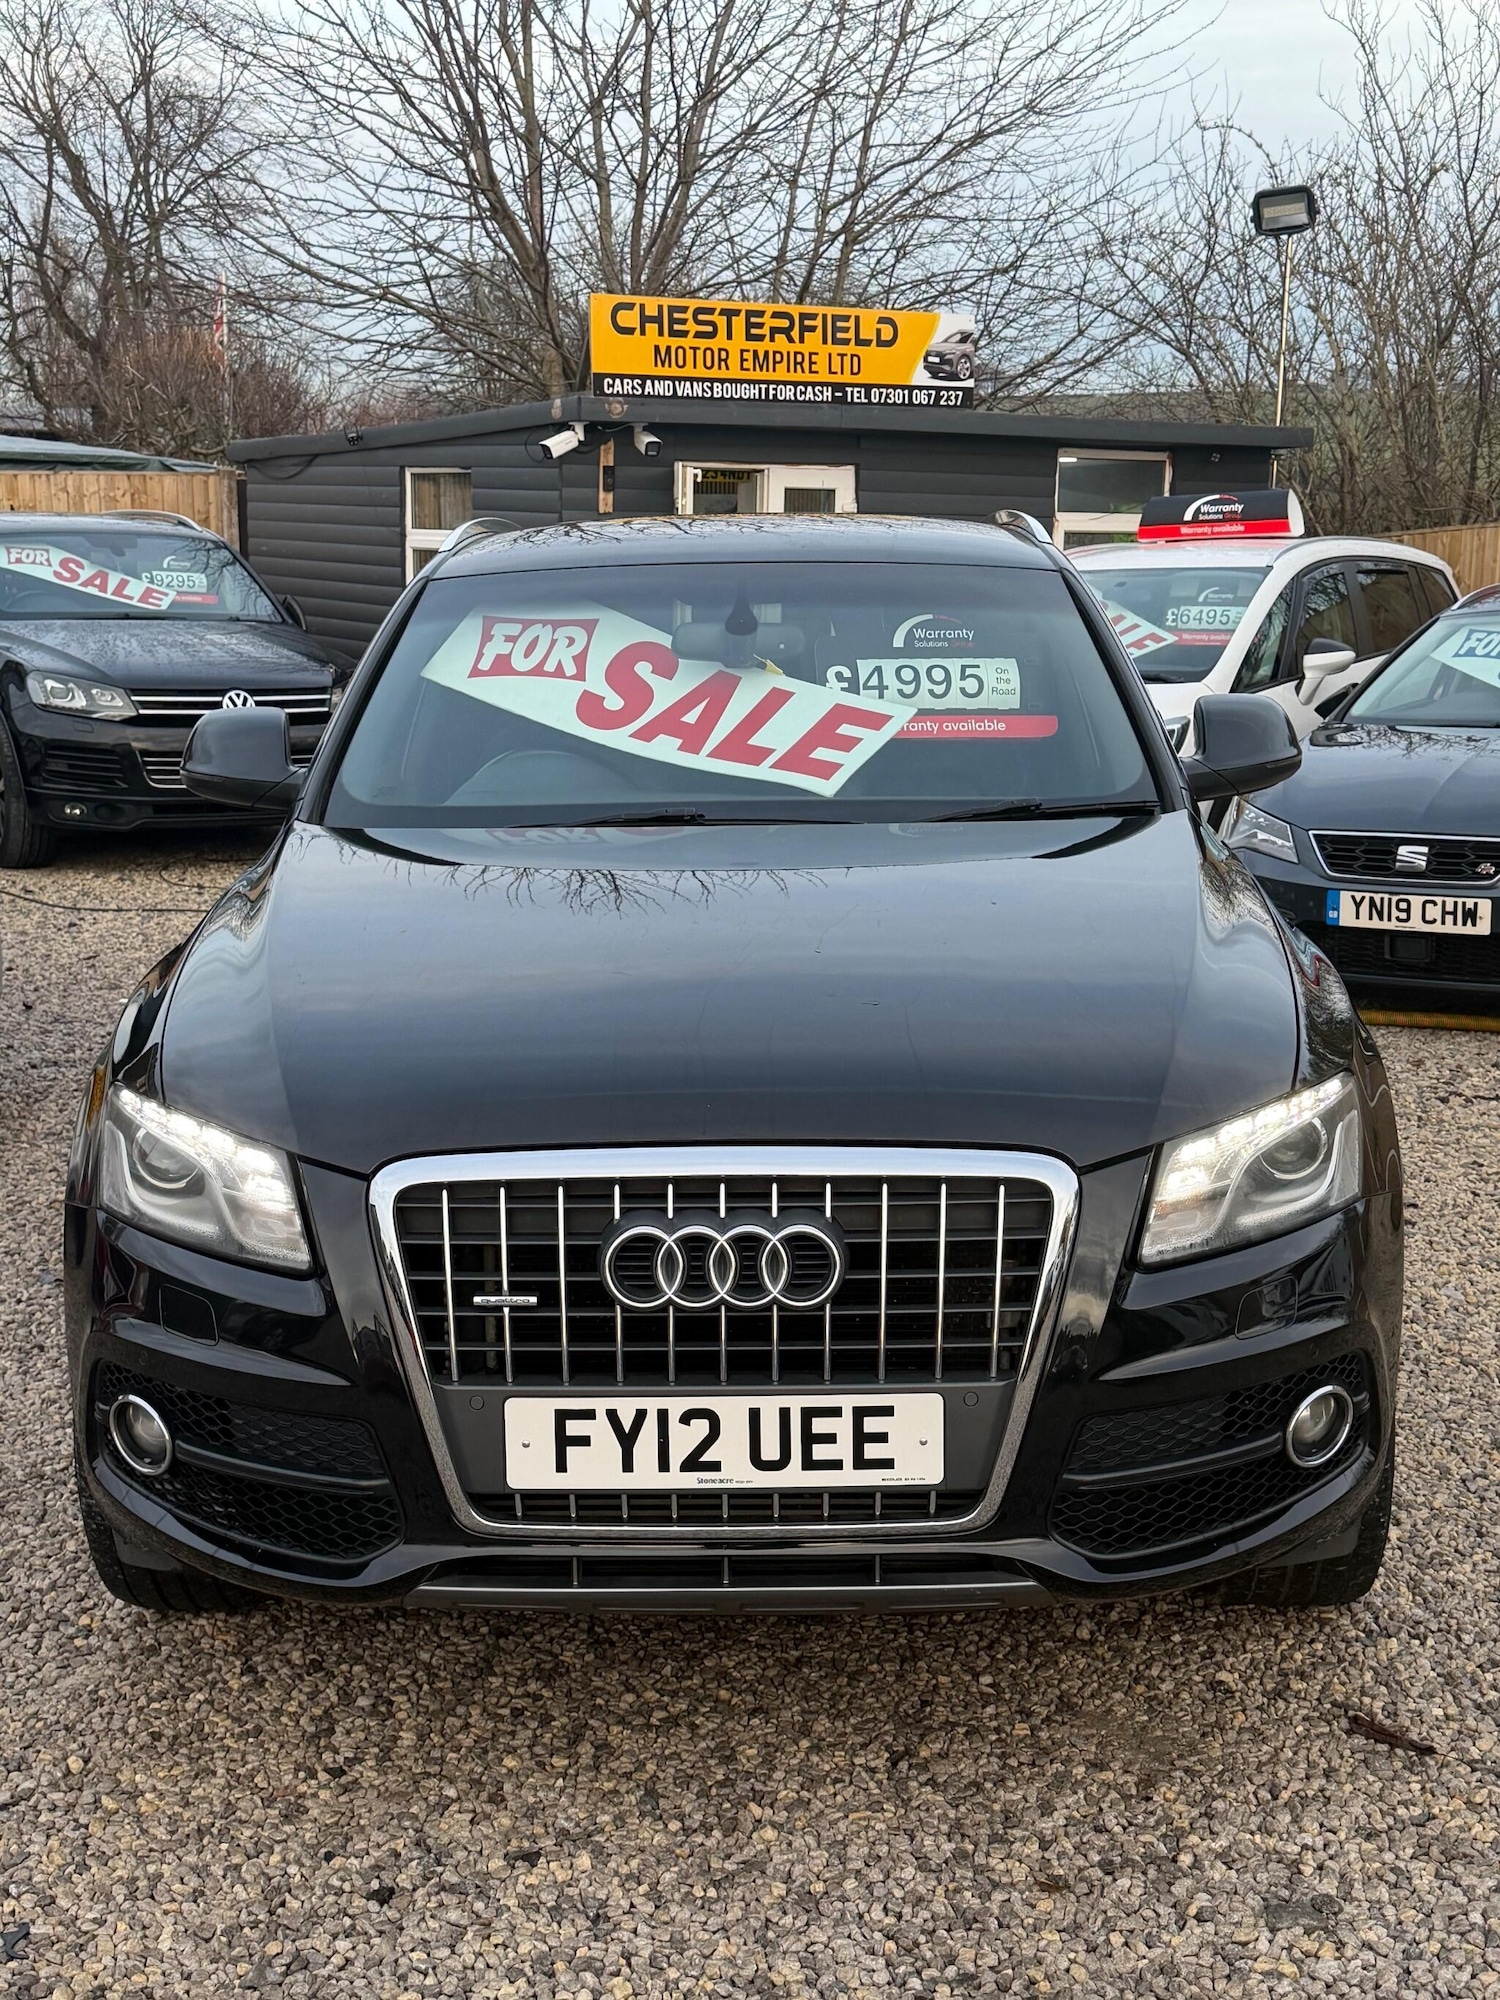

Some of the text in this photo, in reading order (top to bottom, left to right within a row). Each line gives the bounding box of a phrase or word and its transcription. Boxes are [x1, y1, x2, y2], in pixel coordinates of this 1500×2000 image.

[611, 302, 898, 348] CHESTERFIELD
[654, 344, 861, 376] MOTOR EMPIRE LTD
[603, 378, 642, 395] CARS
[644, 379, 673, 396] AND
[674, 381, 711, 398] VANS
[713, 382, 768, 400] BOUGHT
[769, 384, 796, 400] FOR
[796, 385, 832, 402] CASH
[845, 387, 868, 403] TEL
[871, 388, 909, 405] 07301
[912, 389, 935, 405] 067
[939, 391, 963, 406] 237
[1198, 513, 1223, 521] Solutions
[1200, 502, 1244, 515] Warranty
[1180, 524, 1244, 535] Warranty available
[9, 548, 50, 567] FOR
[53, 556, 170, 608] SALE
[1165, 607, 1231, 627] £6495
[912, 627, 975, 642] Warranty
[914, 640, 949, 648] Solutions
[477, 622, 589, 678] FOR
[995, 667, 1009, 675] On
[996, 676, 1011, 685] the
[826, 664, 984, 699] £4995
[991, 687, 1016, 696] Road
[575, 640, 894, 782] SALE
[900, 719, 1006, 734] ranty available
[1350, 894, 1478, 927] YN19 CHW
[554, 1405, 895, 1474] FY12 UEE
[696, 1477, 734, 1486] Stoneacre
